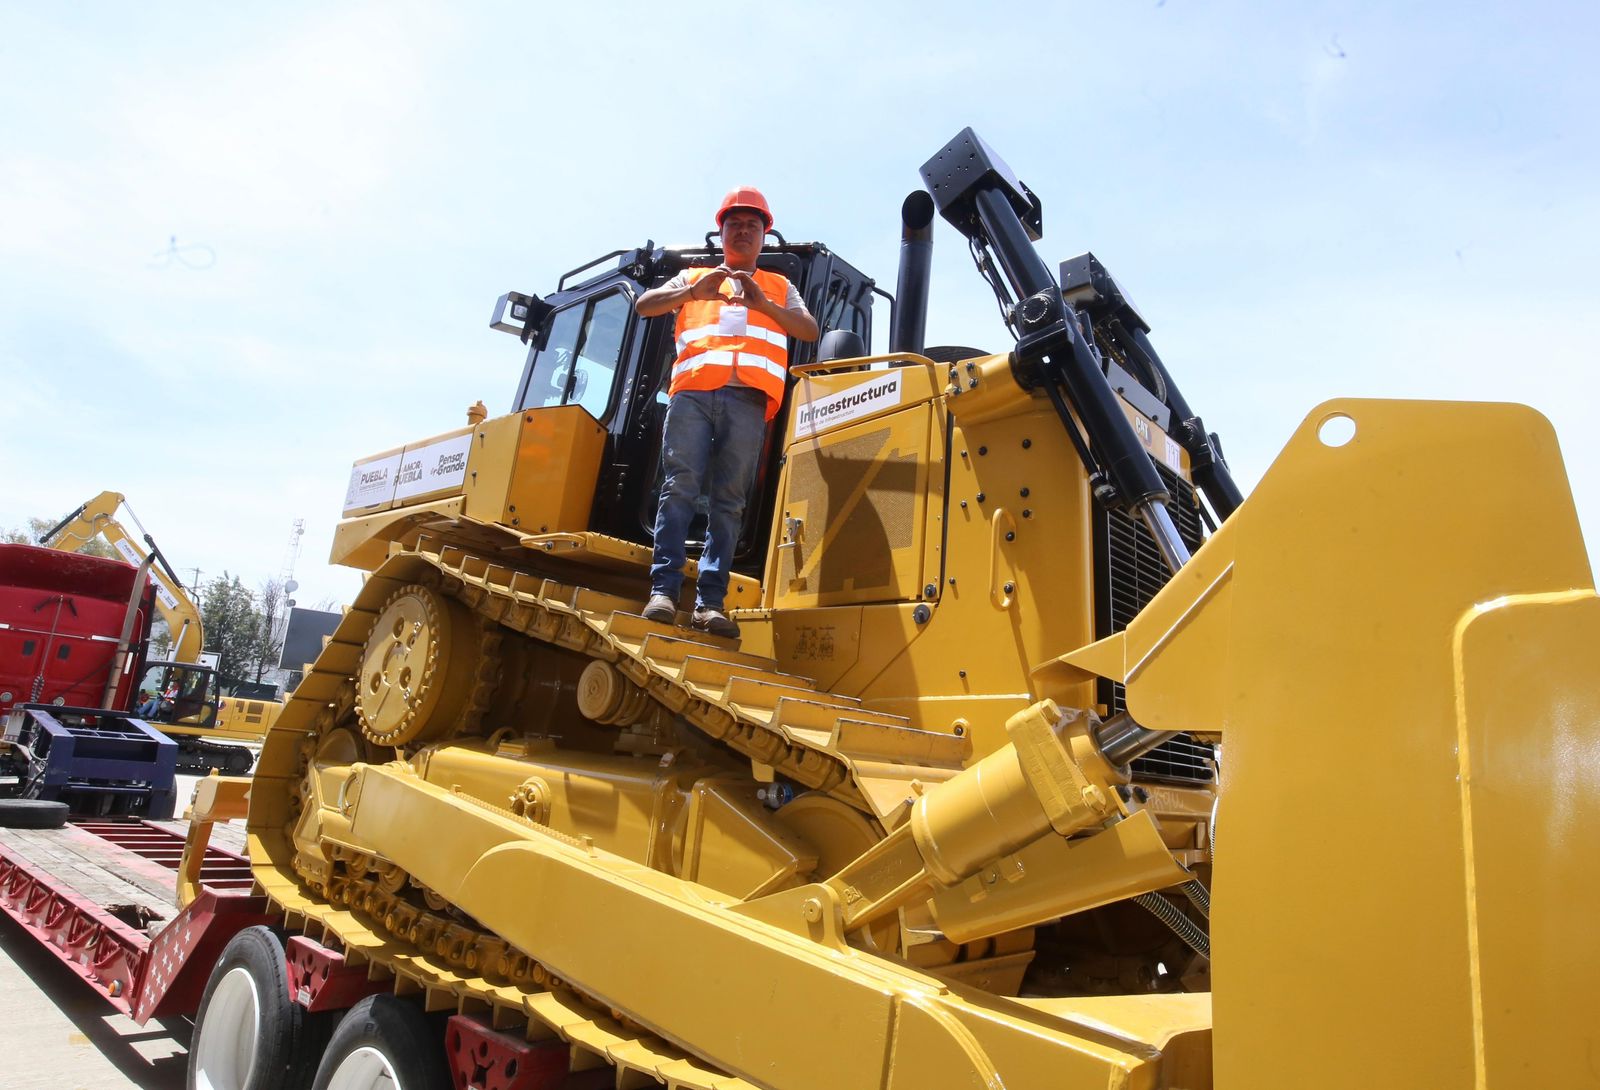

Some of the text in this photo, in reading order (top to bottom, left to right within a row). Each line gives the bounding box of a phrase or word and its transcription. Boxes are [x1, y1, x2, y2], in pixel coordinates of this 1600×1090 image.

[800, 380, 897, 424] Infraestructura
[1135, 416, 1149, 441] CAT
[437, 460, 465, 476] Grande
[438, 452, 465, 467] Pensar
[360, 467, 388, 485] PUEBLA
[393, 468, 423, 486] PUEBLA
